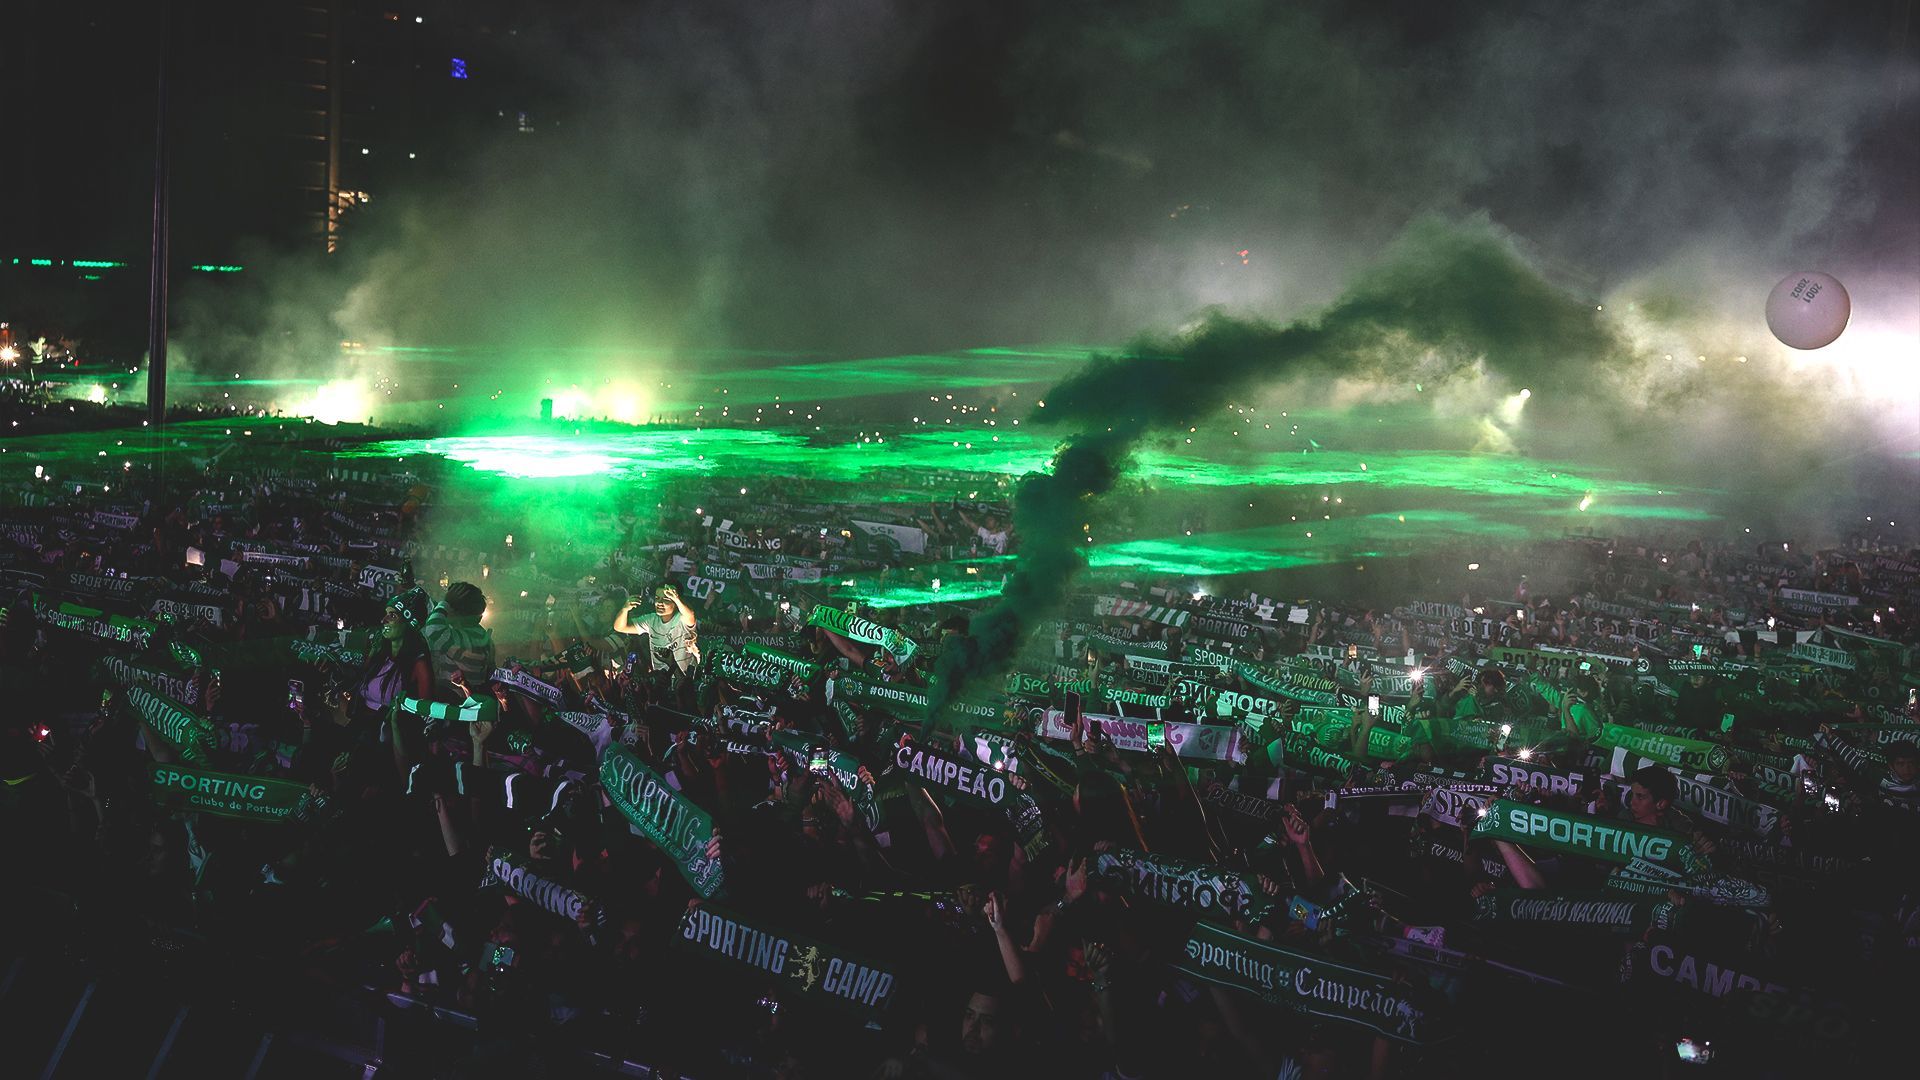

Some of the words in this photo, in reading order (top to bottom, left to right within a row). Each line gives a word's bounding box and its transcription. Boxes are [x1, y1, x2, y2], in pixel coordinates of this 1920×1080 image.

[1791, 278, 1809, 298] 2002
[1803, 282, 1822, 303] 2001
[70, 573, 134, 595] SPORTING
[48, 609, 85, 631] SPORTING
[92, 619, 132, 643] CAMPEÃO
[1191, 615, 1249, 638] SPORTING
[1106, 688, 1166, 708] SPORTING
[1352, 676, 1413, 692] SORTING
[1606, 725, 1682, 764] Sporting
[154, 769, 267, 800] SPORTING
[896, 746, 1005, 804] CAMPEÃO
[190, 794, 224, 809] Clube
[229, 799, 242, 811] de
[246, 803, 292, 817] Portugal
[608, 754, 702, 852] SPORTING
[1510, 808, 1673, 862] SPORTING
[493, 858, 582, 921] SPORTING
[1511, 896, 1569, 921] CAMPEÃO
[1568, 900, 1637, 925] NACIONAL
[684, 910, 789, 975] SPORTING
[1185, 938, 1275, 989] Sporting
[1295, 967, 1402, 1018] Campeão
[1650, 944, 1789, 998] CAMP
